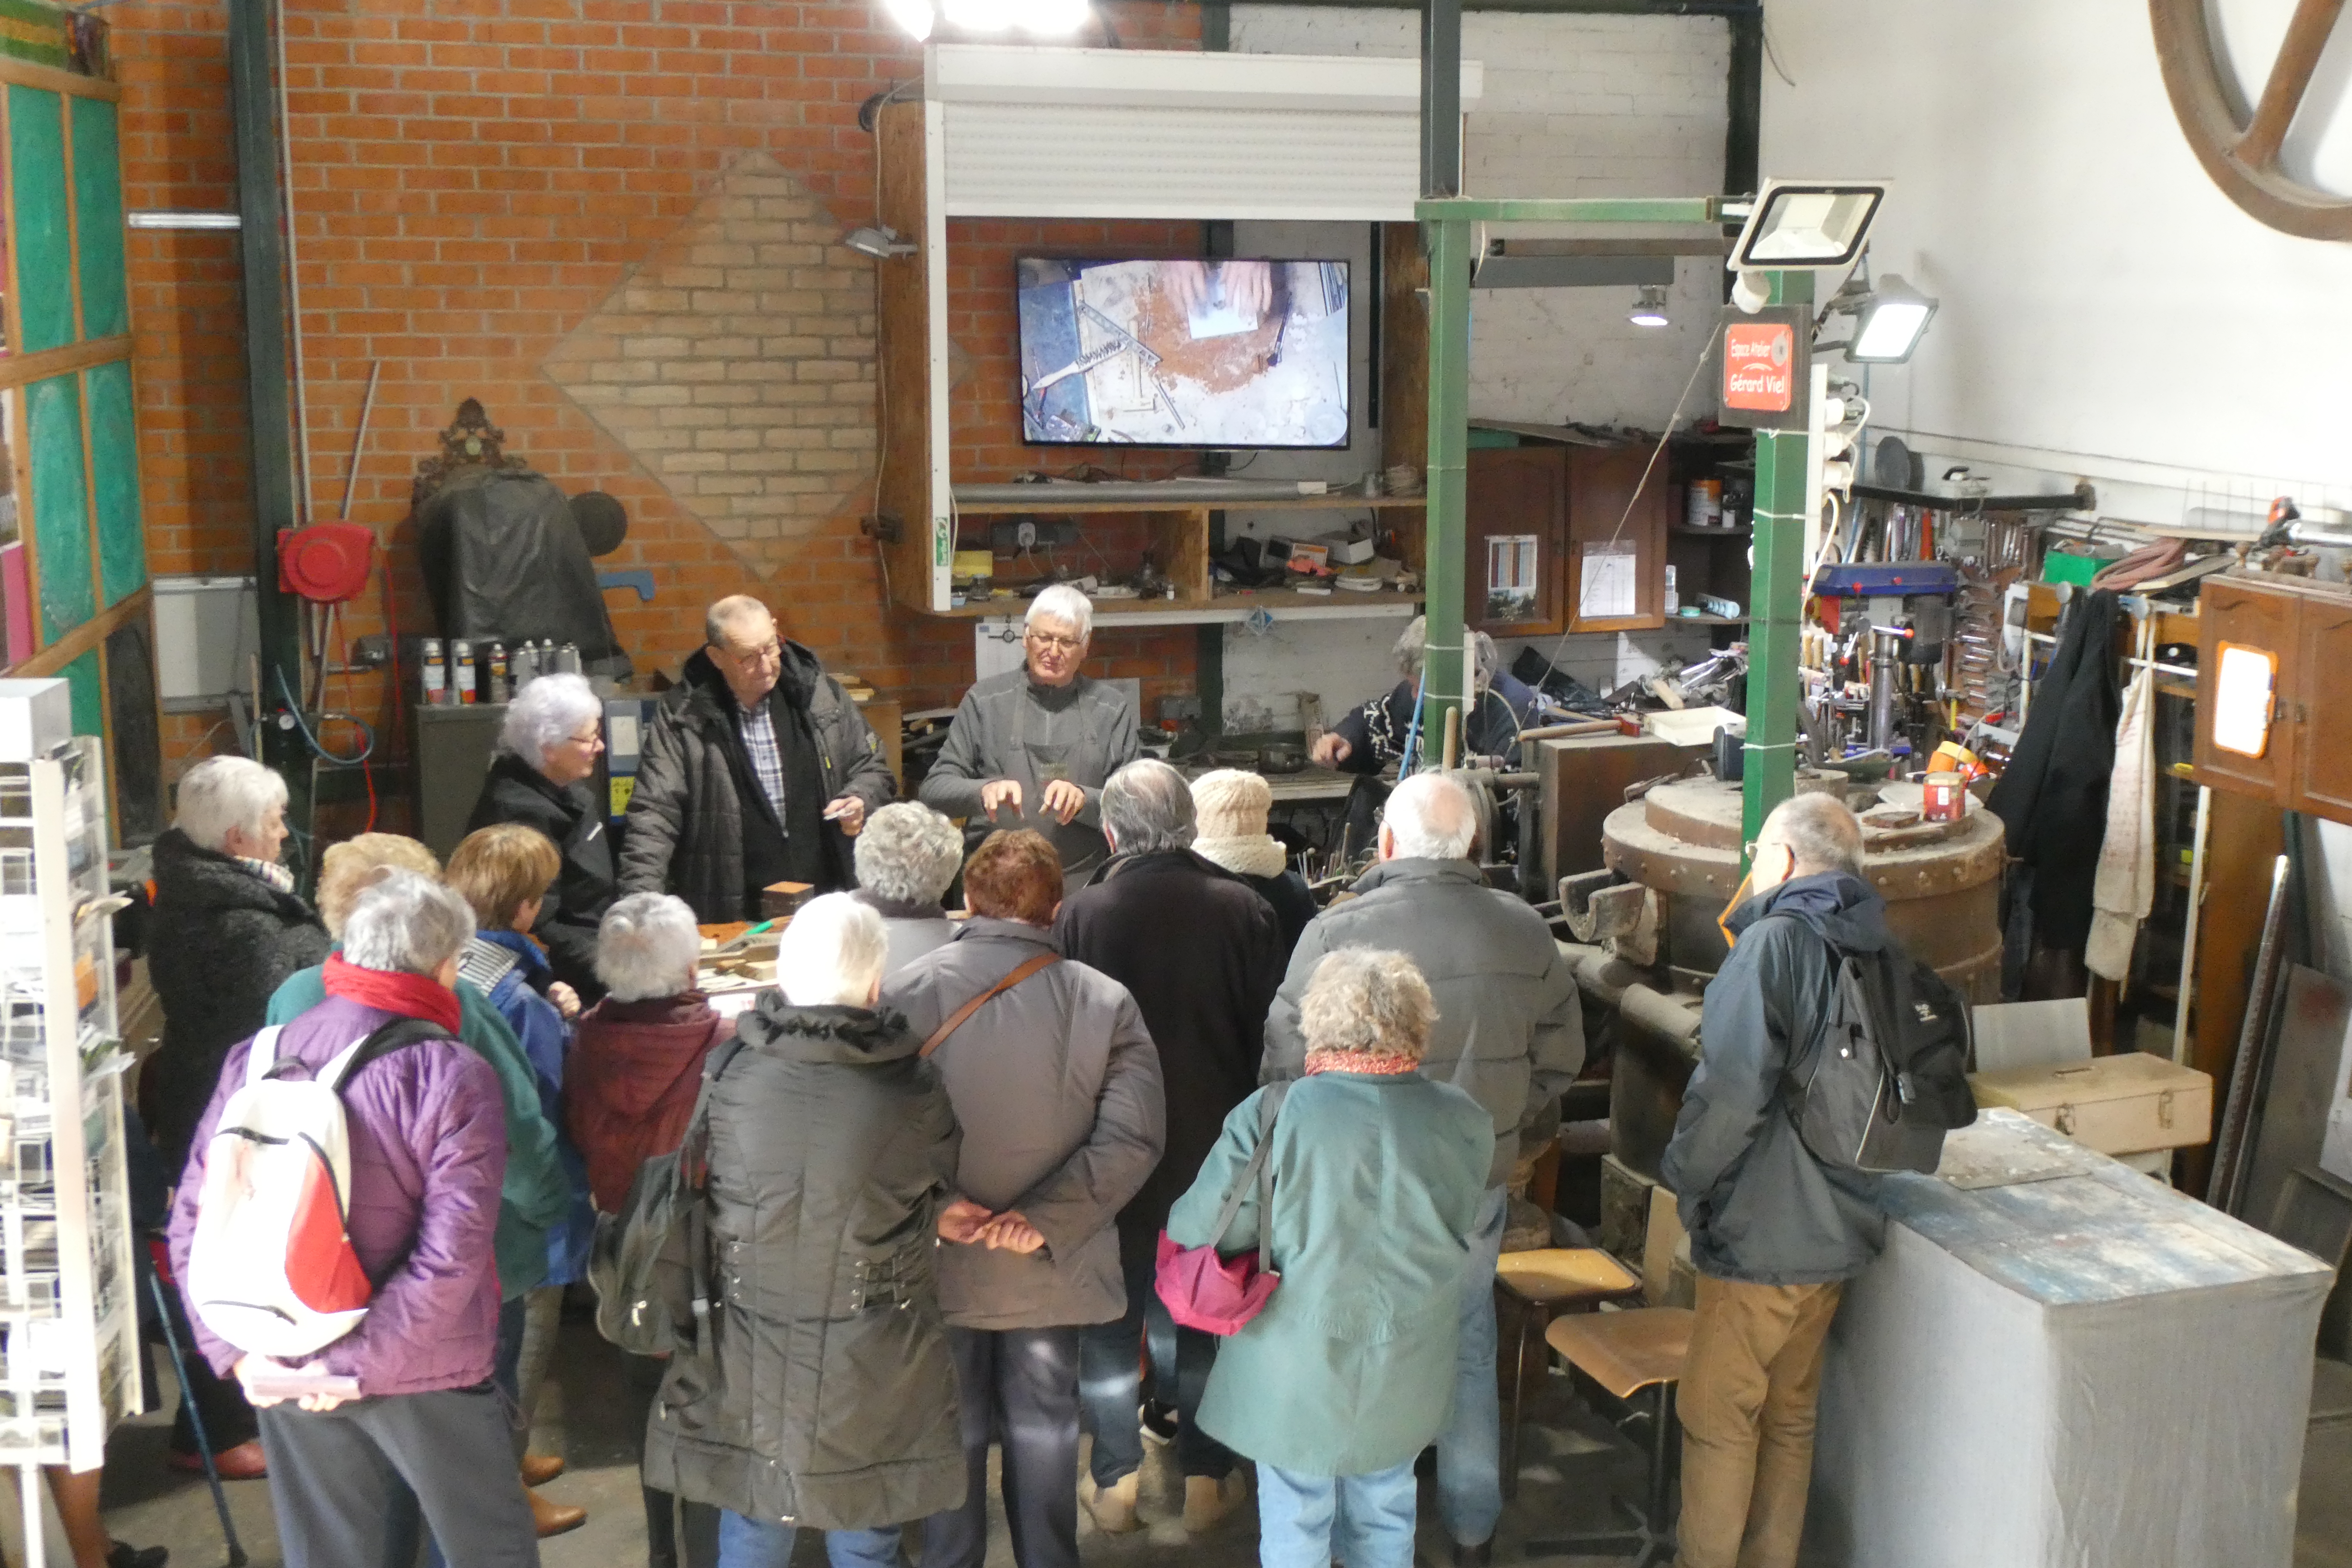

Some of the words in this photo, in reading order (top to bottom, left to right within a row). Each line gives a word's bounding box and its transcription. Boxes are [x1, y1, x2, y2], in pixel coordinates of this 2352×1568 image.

[1731, 339, 1749, 360] Espace
[1750, 341, 1770, 357] Atelier
[1730, 374, 1763, 392] Gérard
[1766, 376, 1785, 394] Viel
